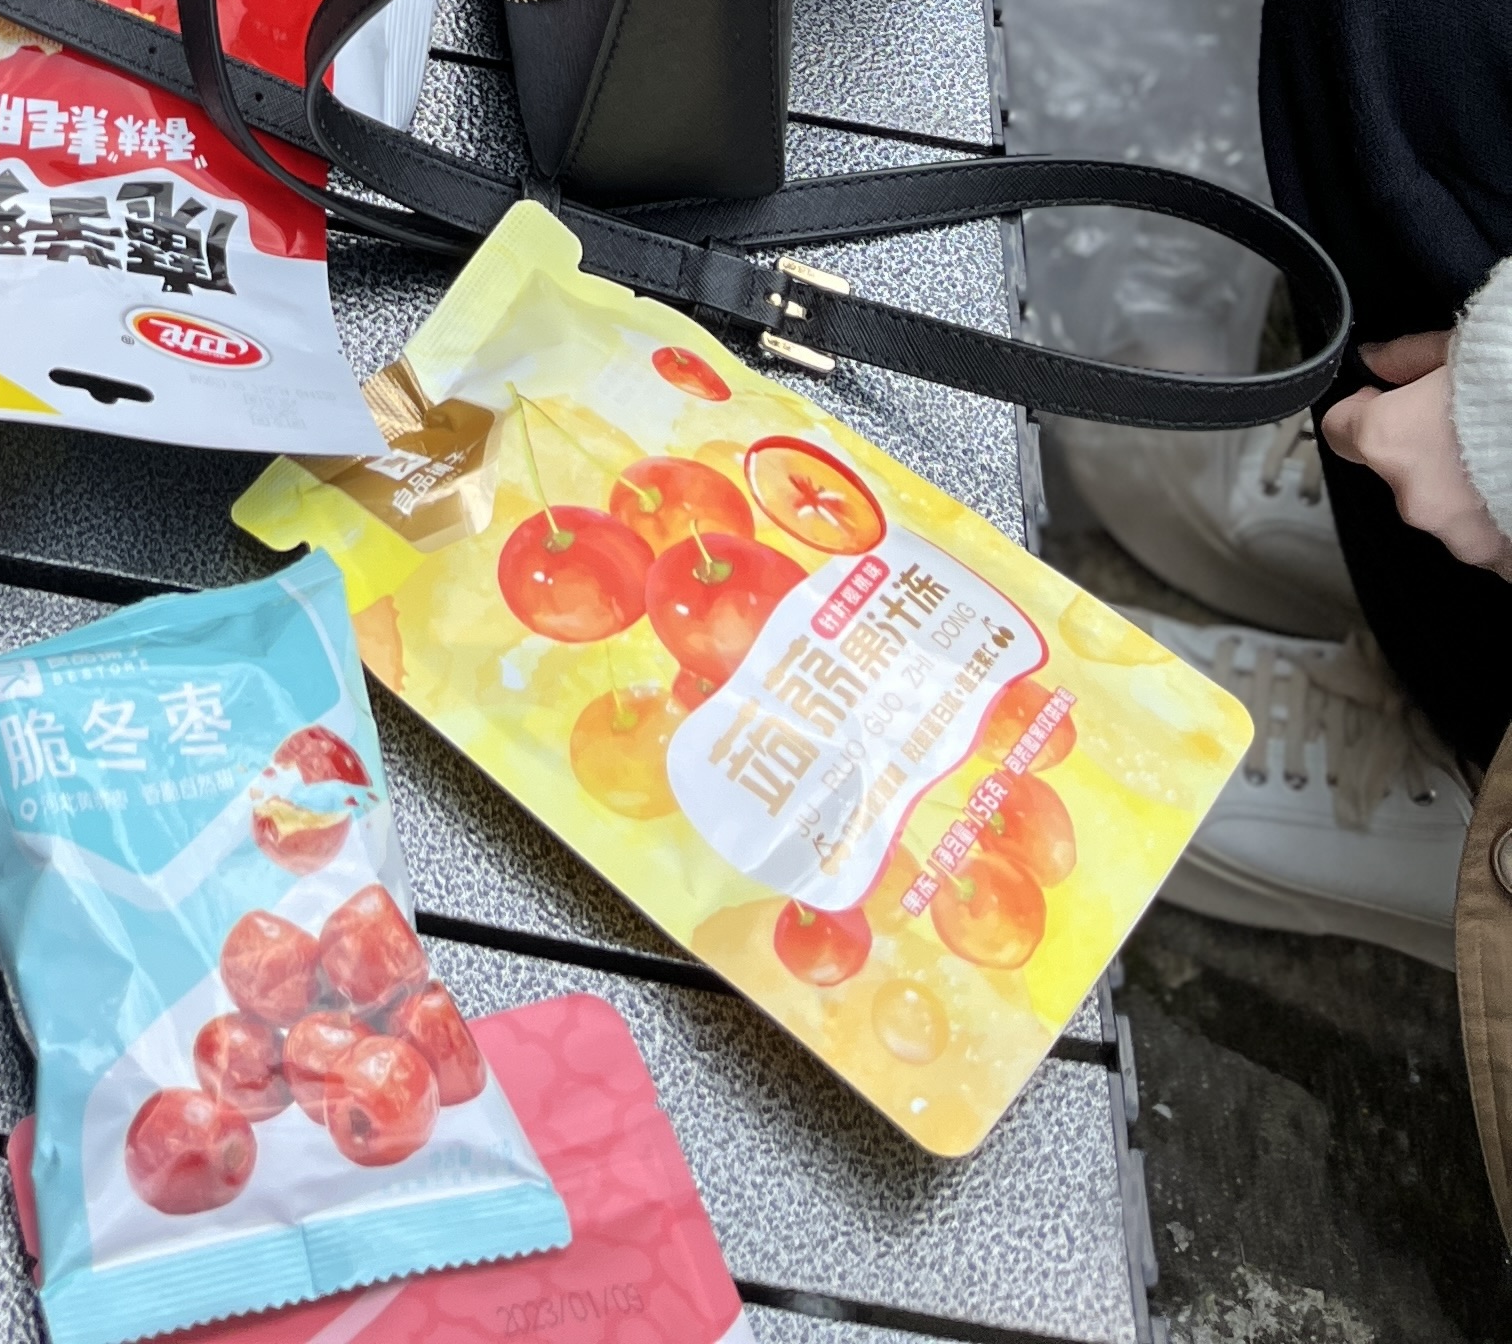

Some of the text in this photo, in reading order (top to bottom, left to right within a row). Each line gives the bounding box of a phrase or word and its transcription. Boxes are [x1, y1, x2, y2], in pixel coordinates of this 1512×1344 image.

[149, 319, 248, 359] 卫龙
[818, 558, 885, 636] 针叶樱桃味
[0, 681, 231, 789] 脆冬枣
[789, 802, 824, 840] JU
[819, 737, 866, 792] RUO
[860, 690, 905, 739] GUO
[900, 651, 935, 690] ZHI
[931, 600, 977, 651] DONG
[900, 872, 940, 916] 果冻
